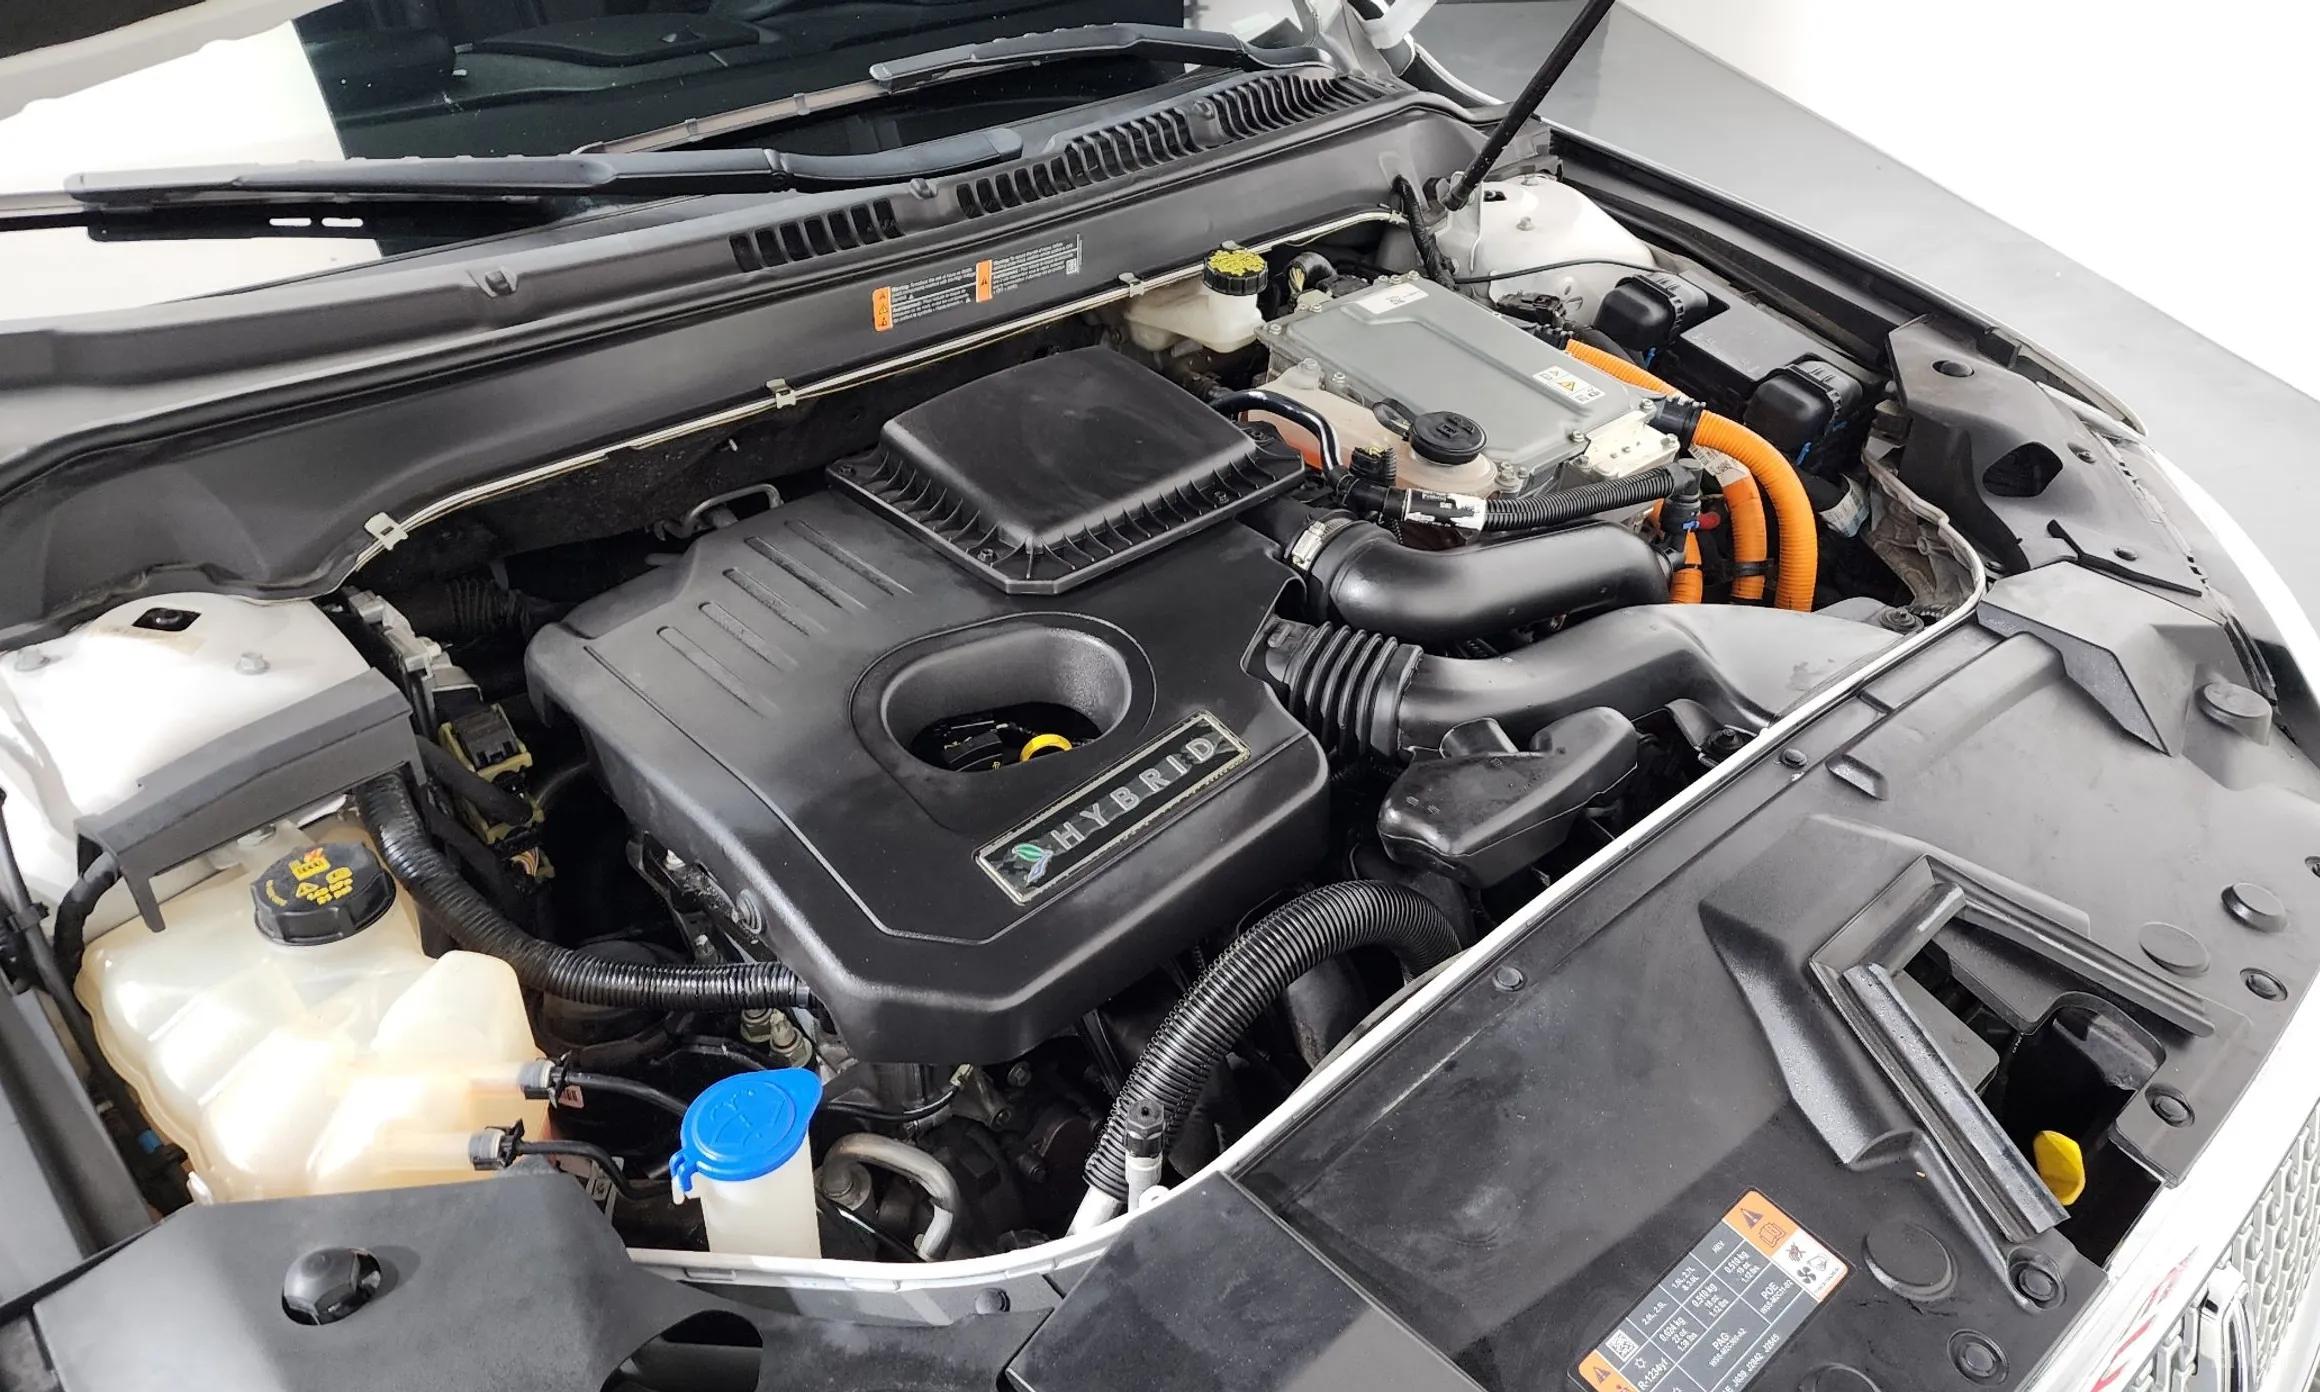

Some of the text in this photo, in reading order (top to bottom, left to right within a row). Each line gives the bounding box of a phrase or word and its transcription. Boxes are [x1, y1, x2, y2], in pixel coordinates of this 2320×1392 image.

[1050, 737, 1216, 851] HYBRID
[1712, 1240, 1725, 1254] HEV
[1724, 1250, 1750, 1274] 0.510 kg
[1691, 1283, 1718, 1308] 0.510 kg
[1760, 1281, 1779, 1300] POE
[1659, 1316, 1687, 1342] 0.624 kg
[1711, 1332, 1729, 1351] PAG
[1637, 1356, 1669, 1391] R-1234yf
[1732, 1370, 1747, 1387] J639
